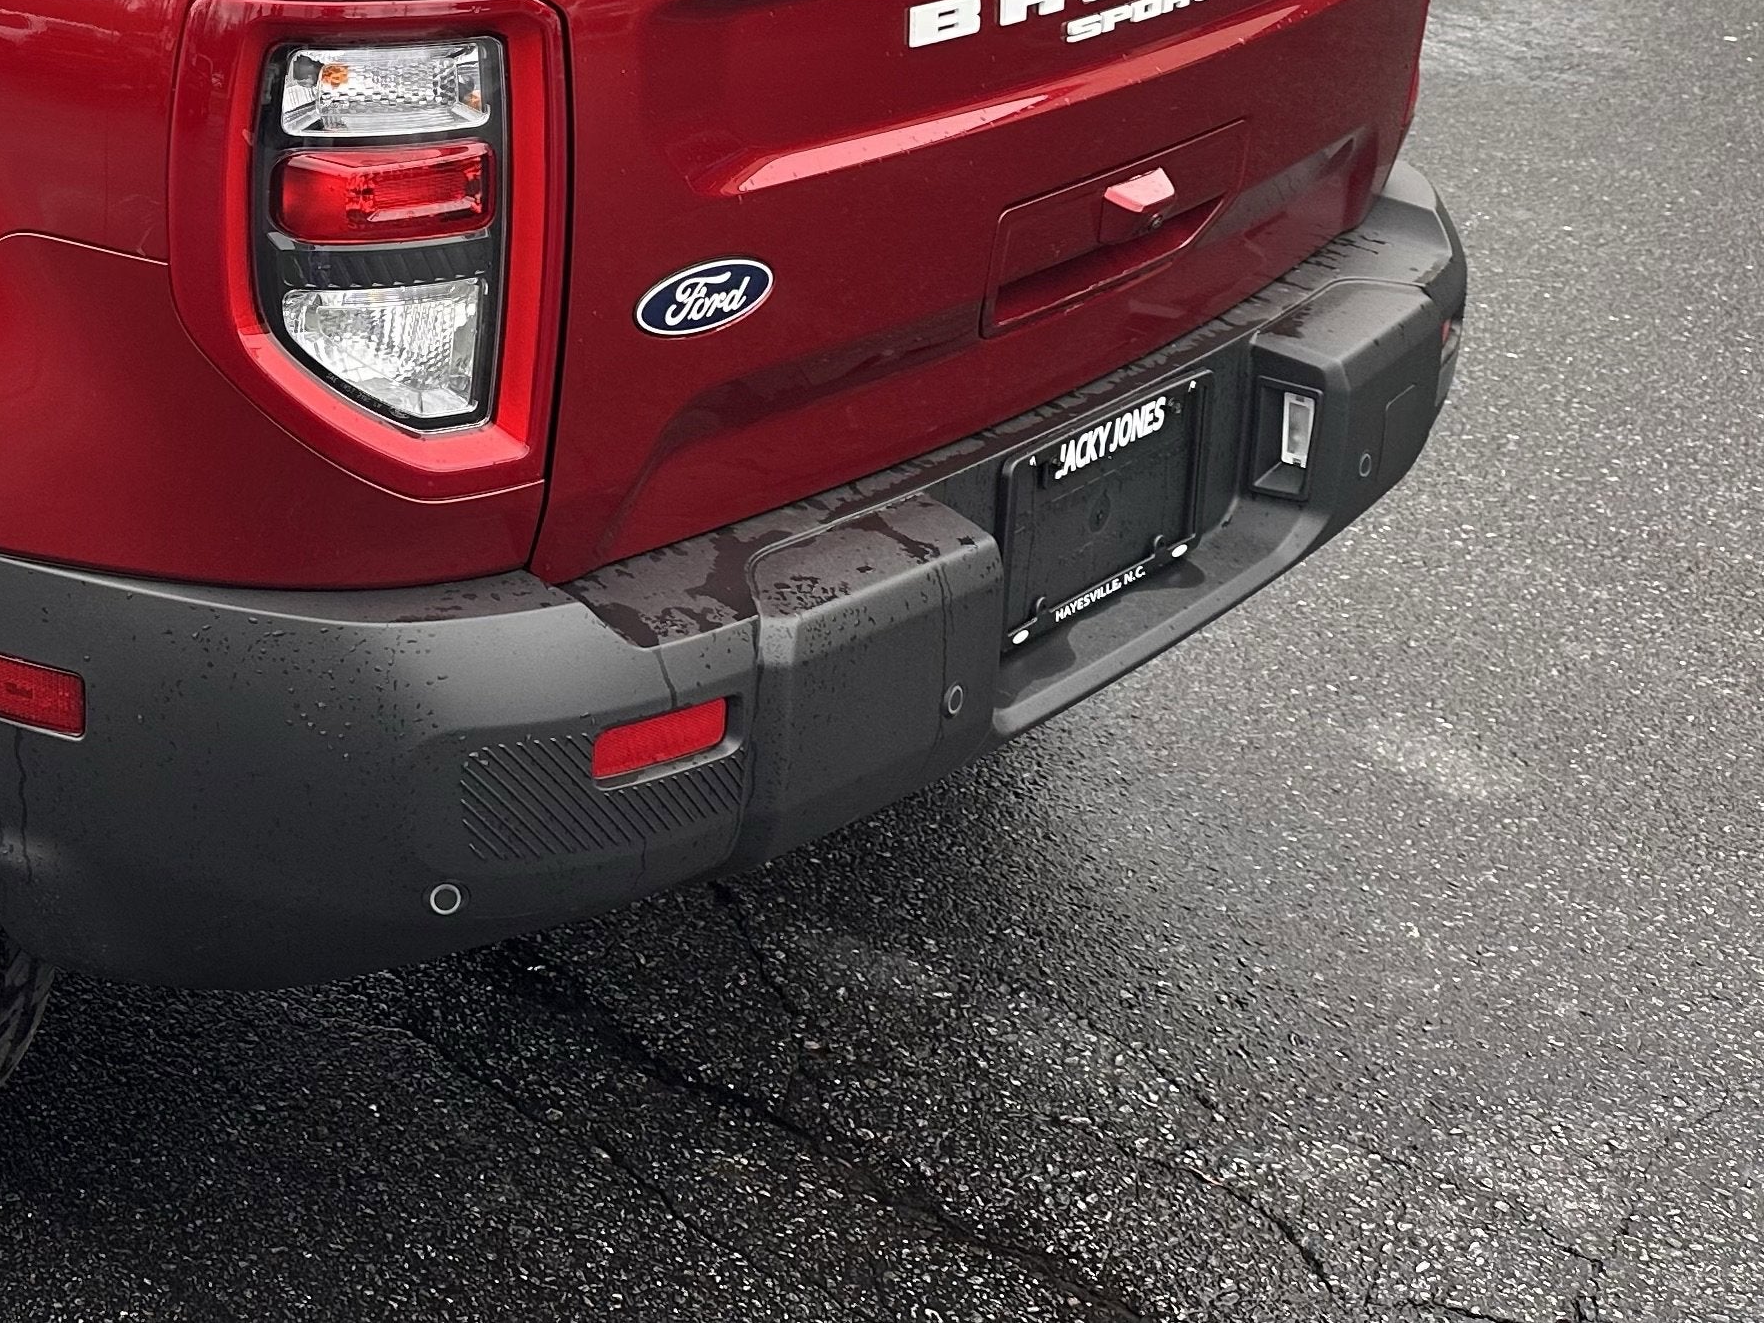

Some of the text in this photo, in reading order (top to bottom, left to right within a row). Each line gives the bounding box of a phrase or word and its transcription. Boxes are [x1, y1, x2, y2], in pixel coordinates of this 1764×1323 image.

[664, 270, 752, 327] Ford
[1054, 395, 1167, 480] JACKY JONES
